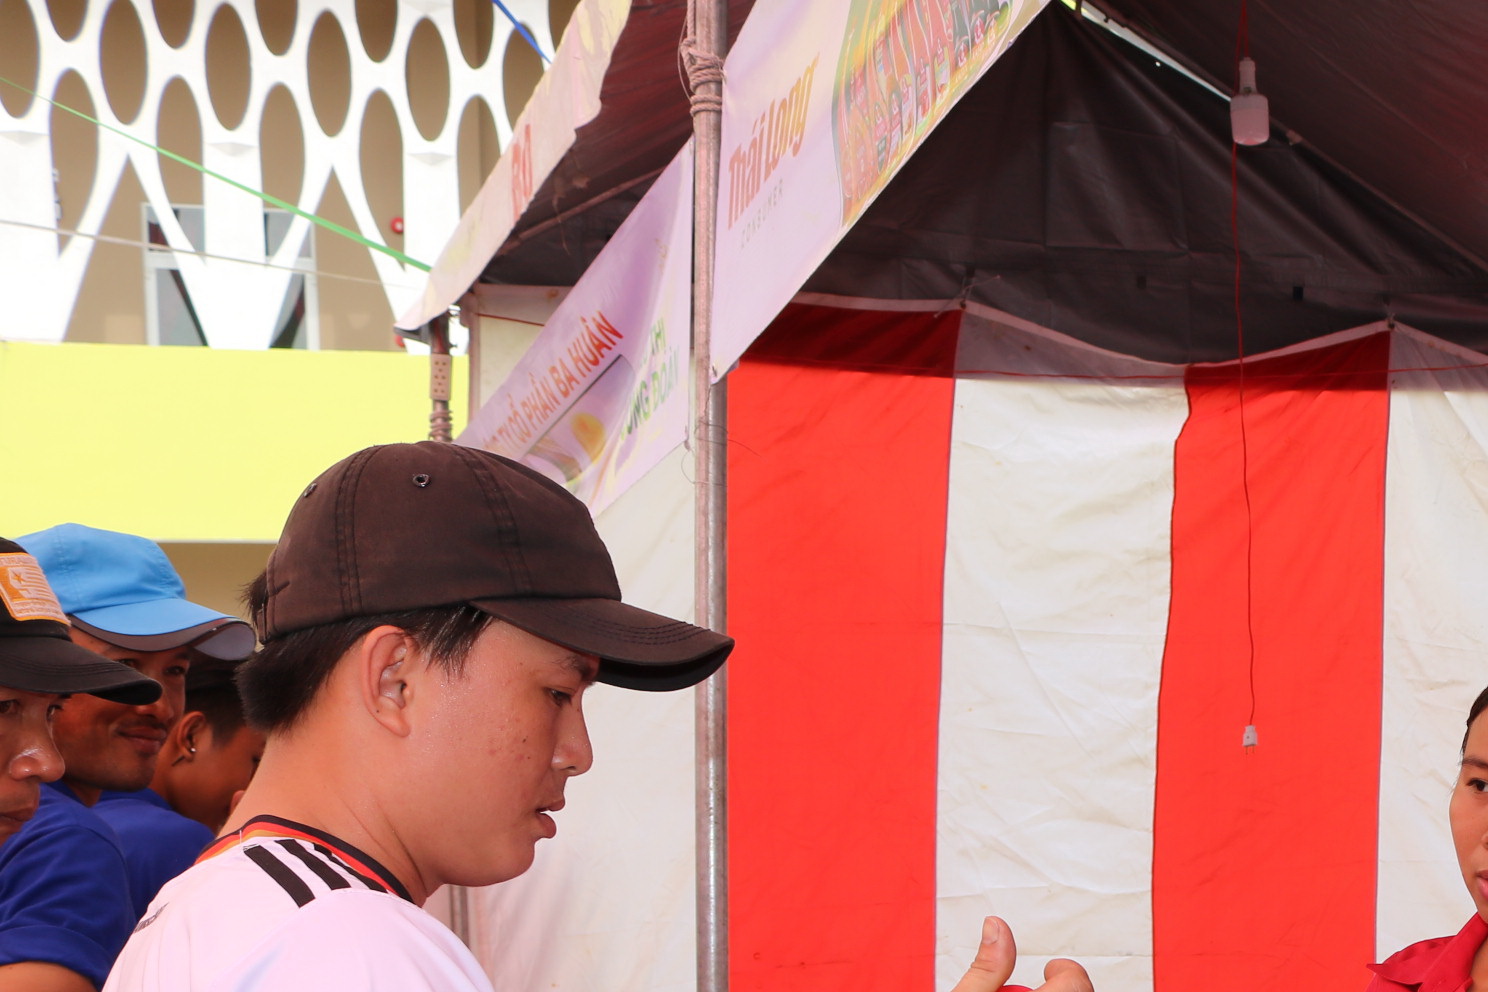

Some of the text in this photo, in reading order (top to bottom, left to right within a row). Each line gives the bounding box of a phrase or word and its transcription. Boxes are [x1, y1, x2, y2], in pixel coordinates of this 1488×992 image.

[728, 51, 820, 230] Thái Long
[547, 356, 582, 398] BA
